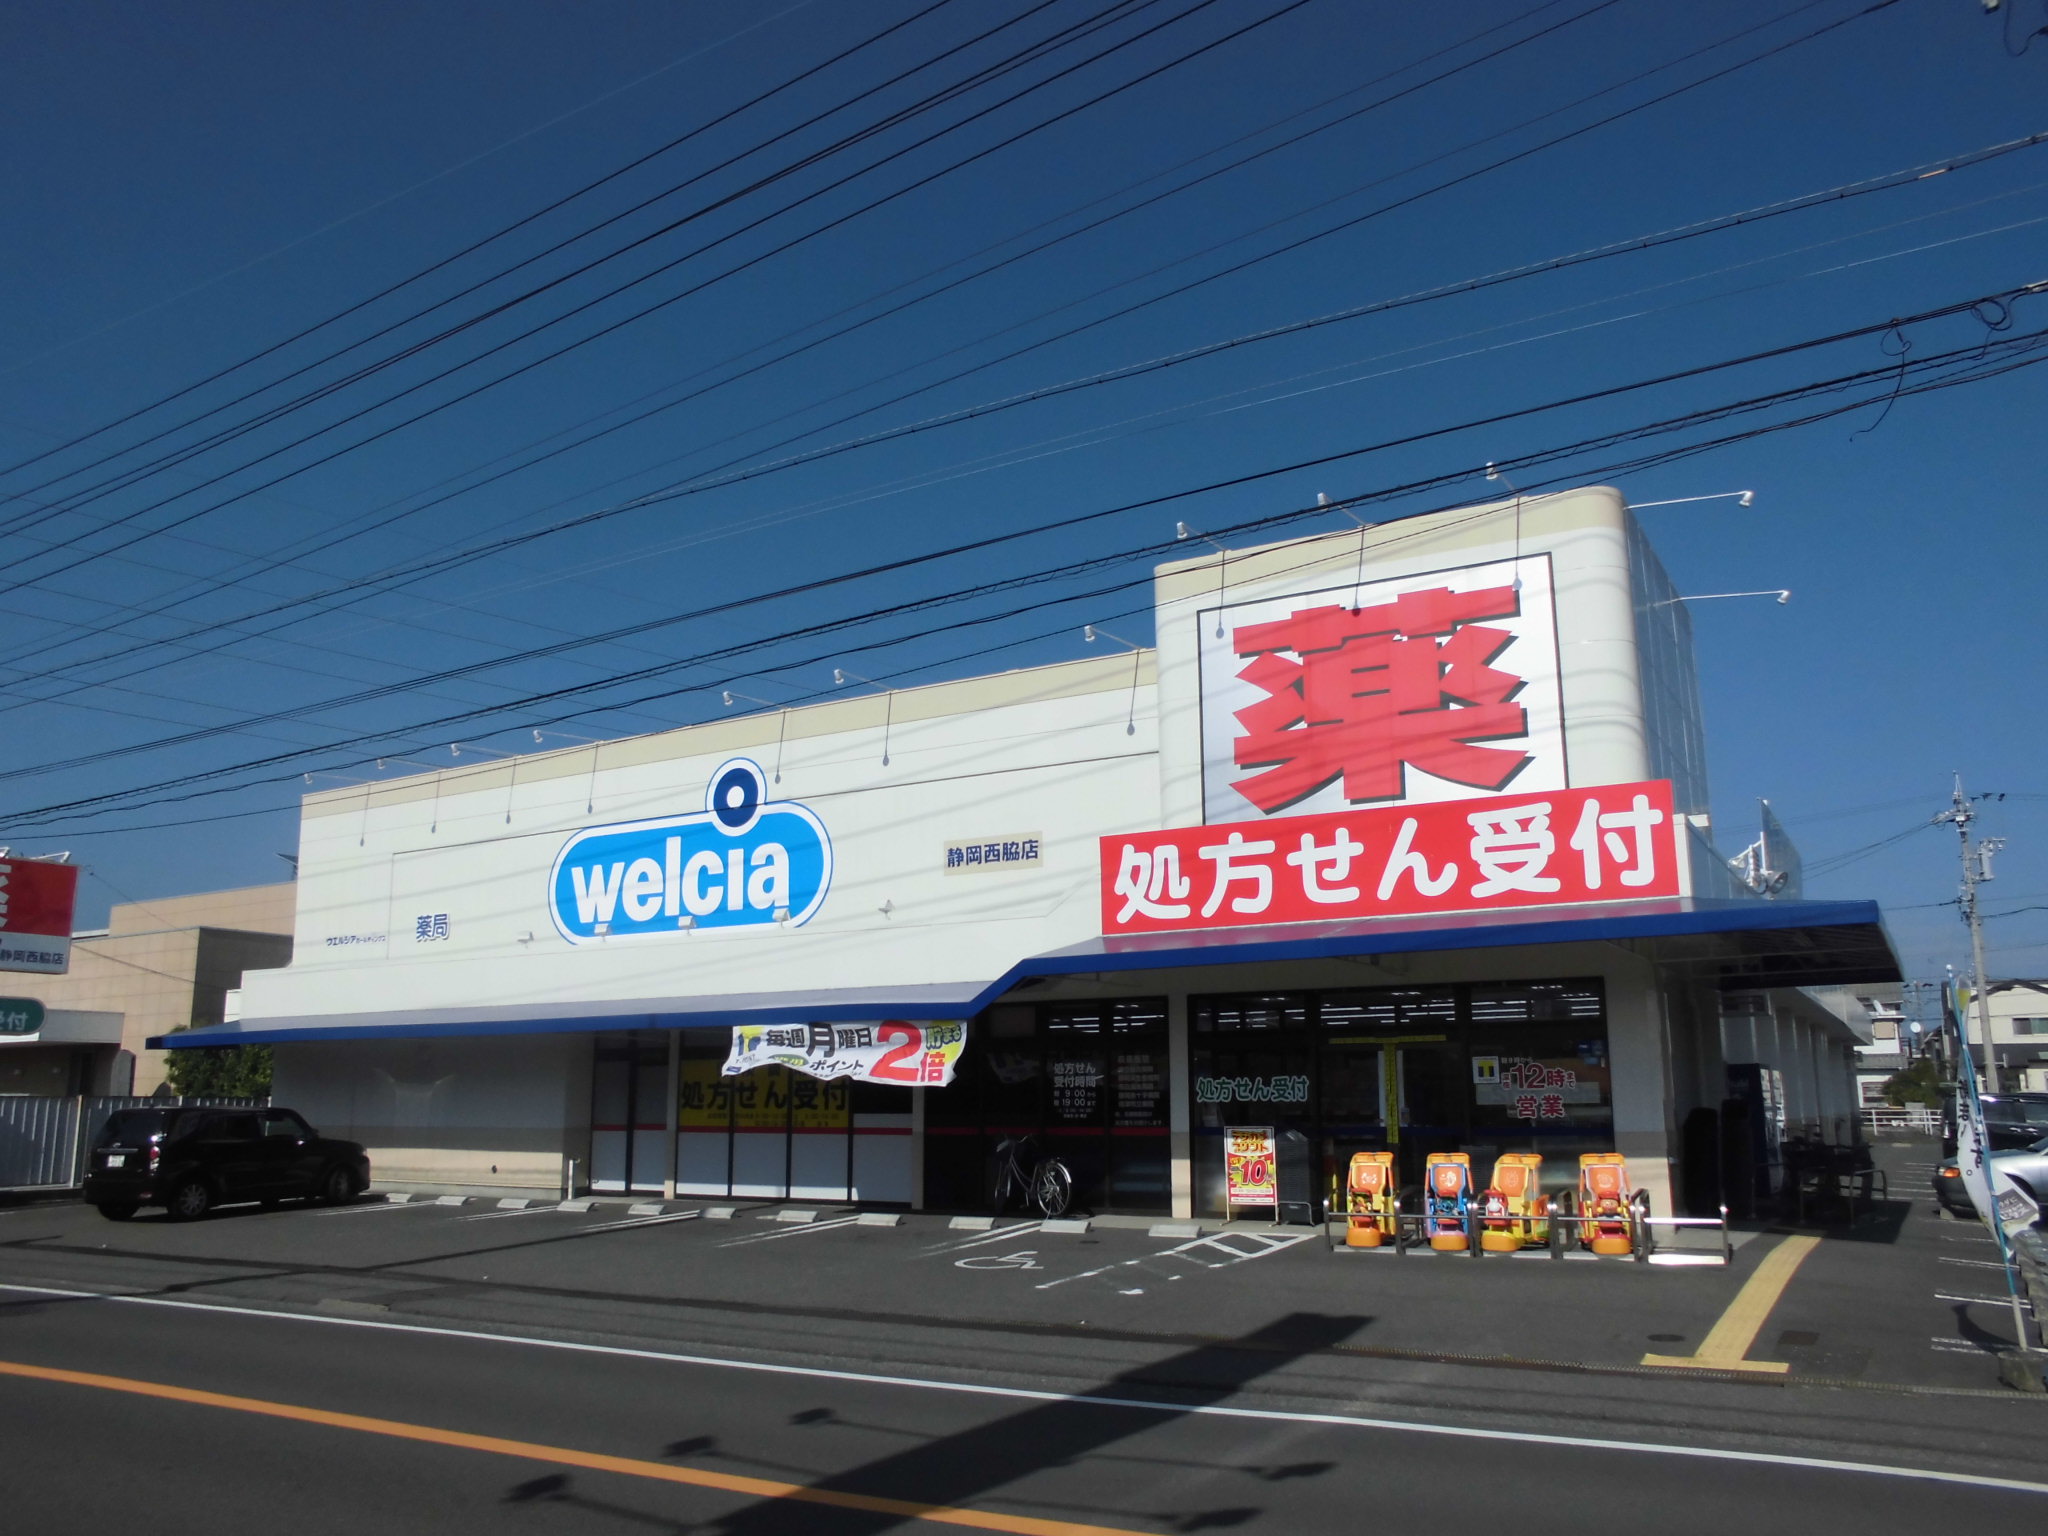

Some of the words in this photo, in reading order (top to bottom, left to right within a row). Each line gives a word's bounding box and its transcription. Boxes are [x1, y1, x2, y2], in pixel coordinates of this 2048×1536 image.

[1229, 585, 1535, 815] 薬
[571, 768, 789, 923] welcia
[946, 839, 1038, 868] 静岡西脇店
[1114, 794, 1663, 924] 処方せん受付
[416, 913, 448, 941] 薬局
[766, 1022, 872, 1057] 毎週月曜日
[809, 1059, 864, 1072] ポイント
[1053, 1062, 1096, 1074] 処方せん
[682, 1079, 849, 1111] 処方せん受付
[1053, 1075, 1096, 1088] 受付時間
[1196, 1075, 1310, 1103] 処方せん受付
[1516, 1093, 1565, 1119] 営業
[1240, 1159, 1268, 1186] 10
